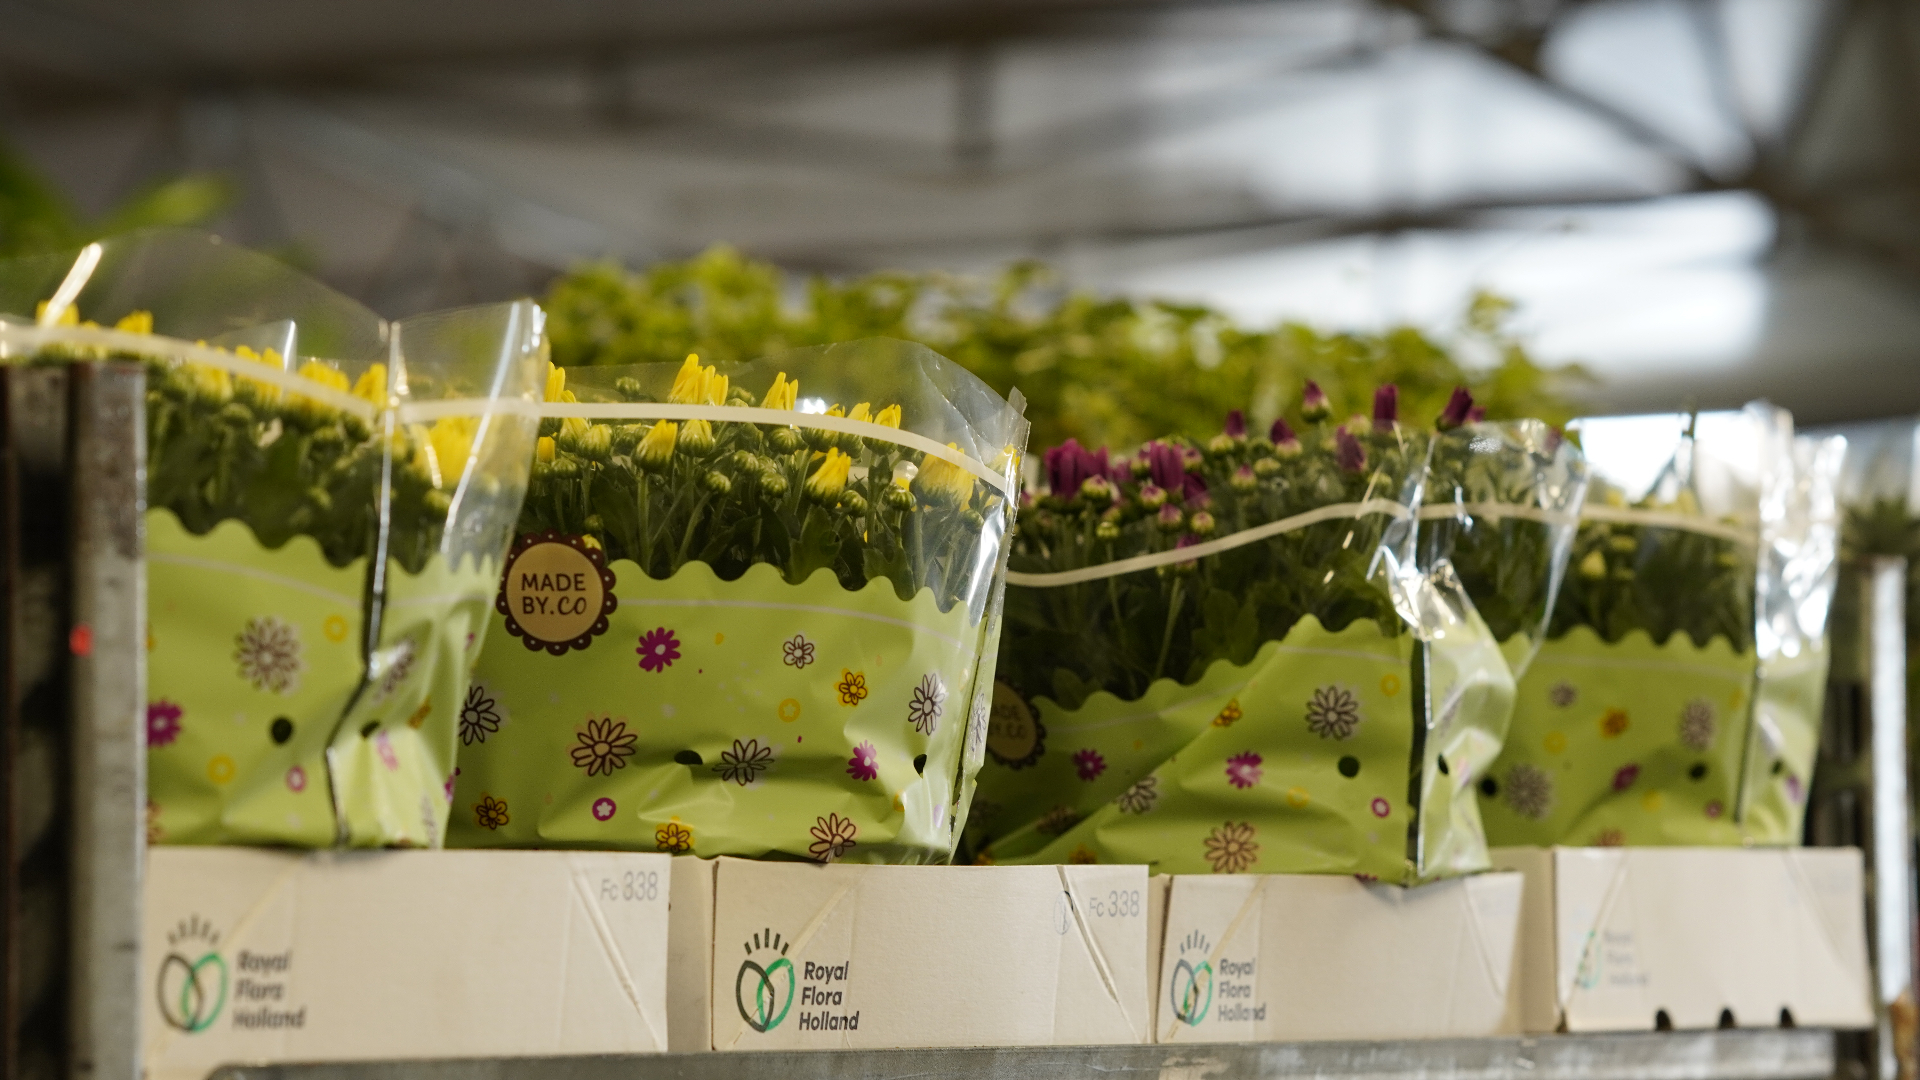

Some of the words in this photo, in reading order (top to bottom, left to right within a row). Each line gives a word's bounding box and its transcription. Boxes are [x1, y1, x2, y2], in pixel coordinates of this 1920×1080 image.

[521, 573, 586, 591] MADE
[600, 878, 618, 901] Fc
[1088, 896, 1105, 917] Fc
[1107, 889, 1140, 918] 338
[237, 949, 293, 976] Royal
[803, 960, 849, 985] Royal
[1219, 957, 1256, 979] Royal
[801, 987, 843, 1006] Flora
[1218, 981, 1252, 998] Flora
[798, 1011, 860, 1031] Holland
